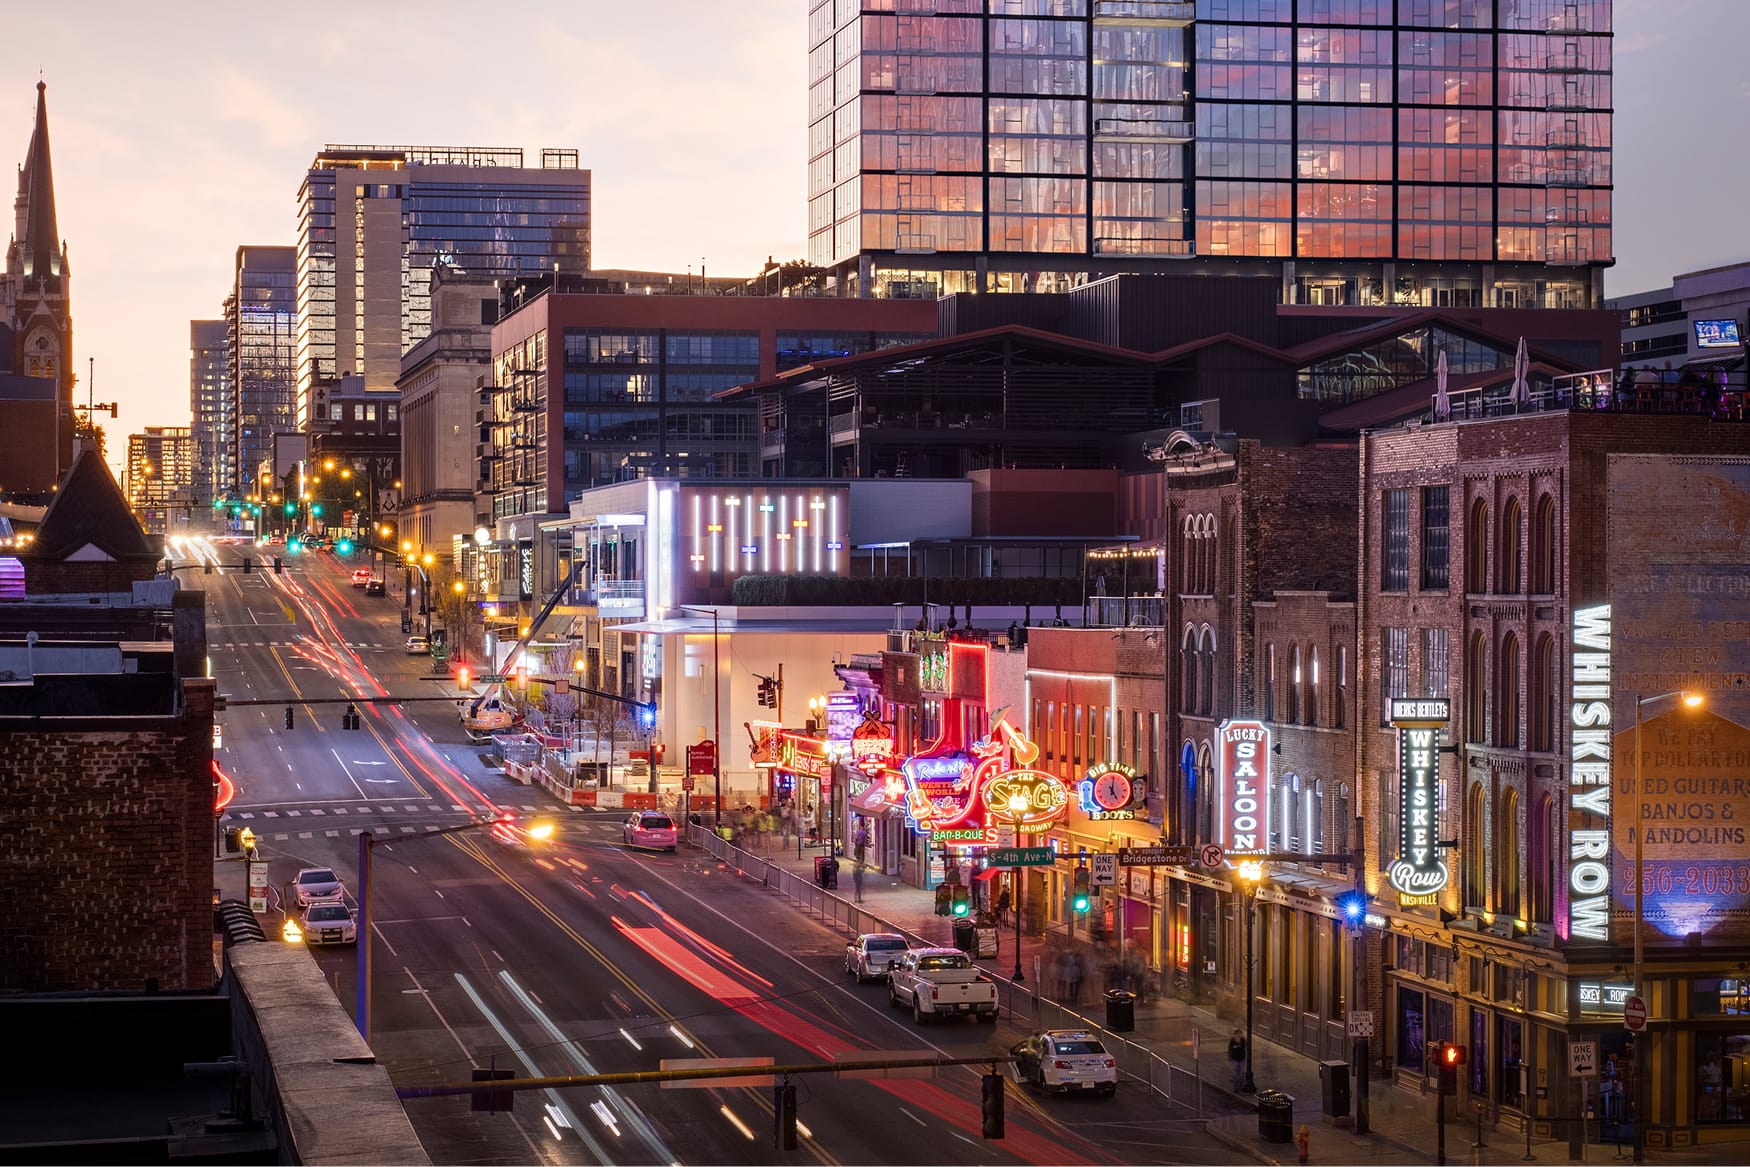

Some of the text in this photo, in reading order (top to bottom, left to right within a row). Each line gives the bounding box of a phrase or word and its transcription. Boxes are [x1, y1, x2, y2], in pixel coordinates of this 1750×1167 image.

[1225, 728, 1264, 742] LUCKY
[1655, 751, 1720, 768] DOLLAR
[1088, 762, 1136, 778] BIG TIME
[1571, 604, 1612, 942] WHISKEY ROW
[1017, 773, 1035, 781] THE
[989, 778, 1067, 813] STAGE
[1233, 742, 1258, 849] SALOON
[1409, 730, 1432, 865] WHISKEY
[1092, 810, 1134, 820] BOOTS
[1641, 803, 1734, 820] BANJOS &
[933, 830, 984, 840] BAR-B-QUE
[1096, 856, 1113, 865] ONE
[1123, 854, 1178, 865] Bridgestone
[1095, 864, 1113, 873] WAY
[1397, 864, 1443, 889] Row
[1623, 864, 1750, 896] 256-2033
[1400, 893, 1438, 906] NASHVILLE
[1350, 1023, 1360, 1033] OK
[1573, 1044, 1591, 1054] ONE
[1573, 1053, 1592, 1063] WAY
